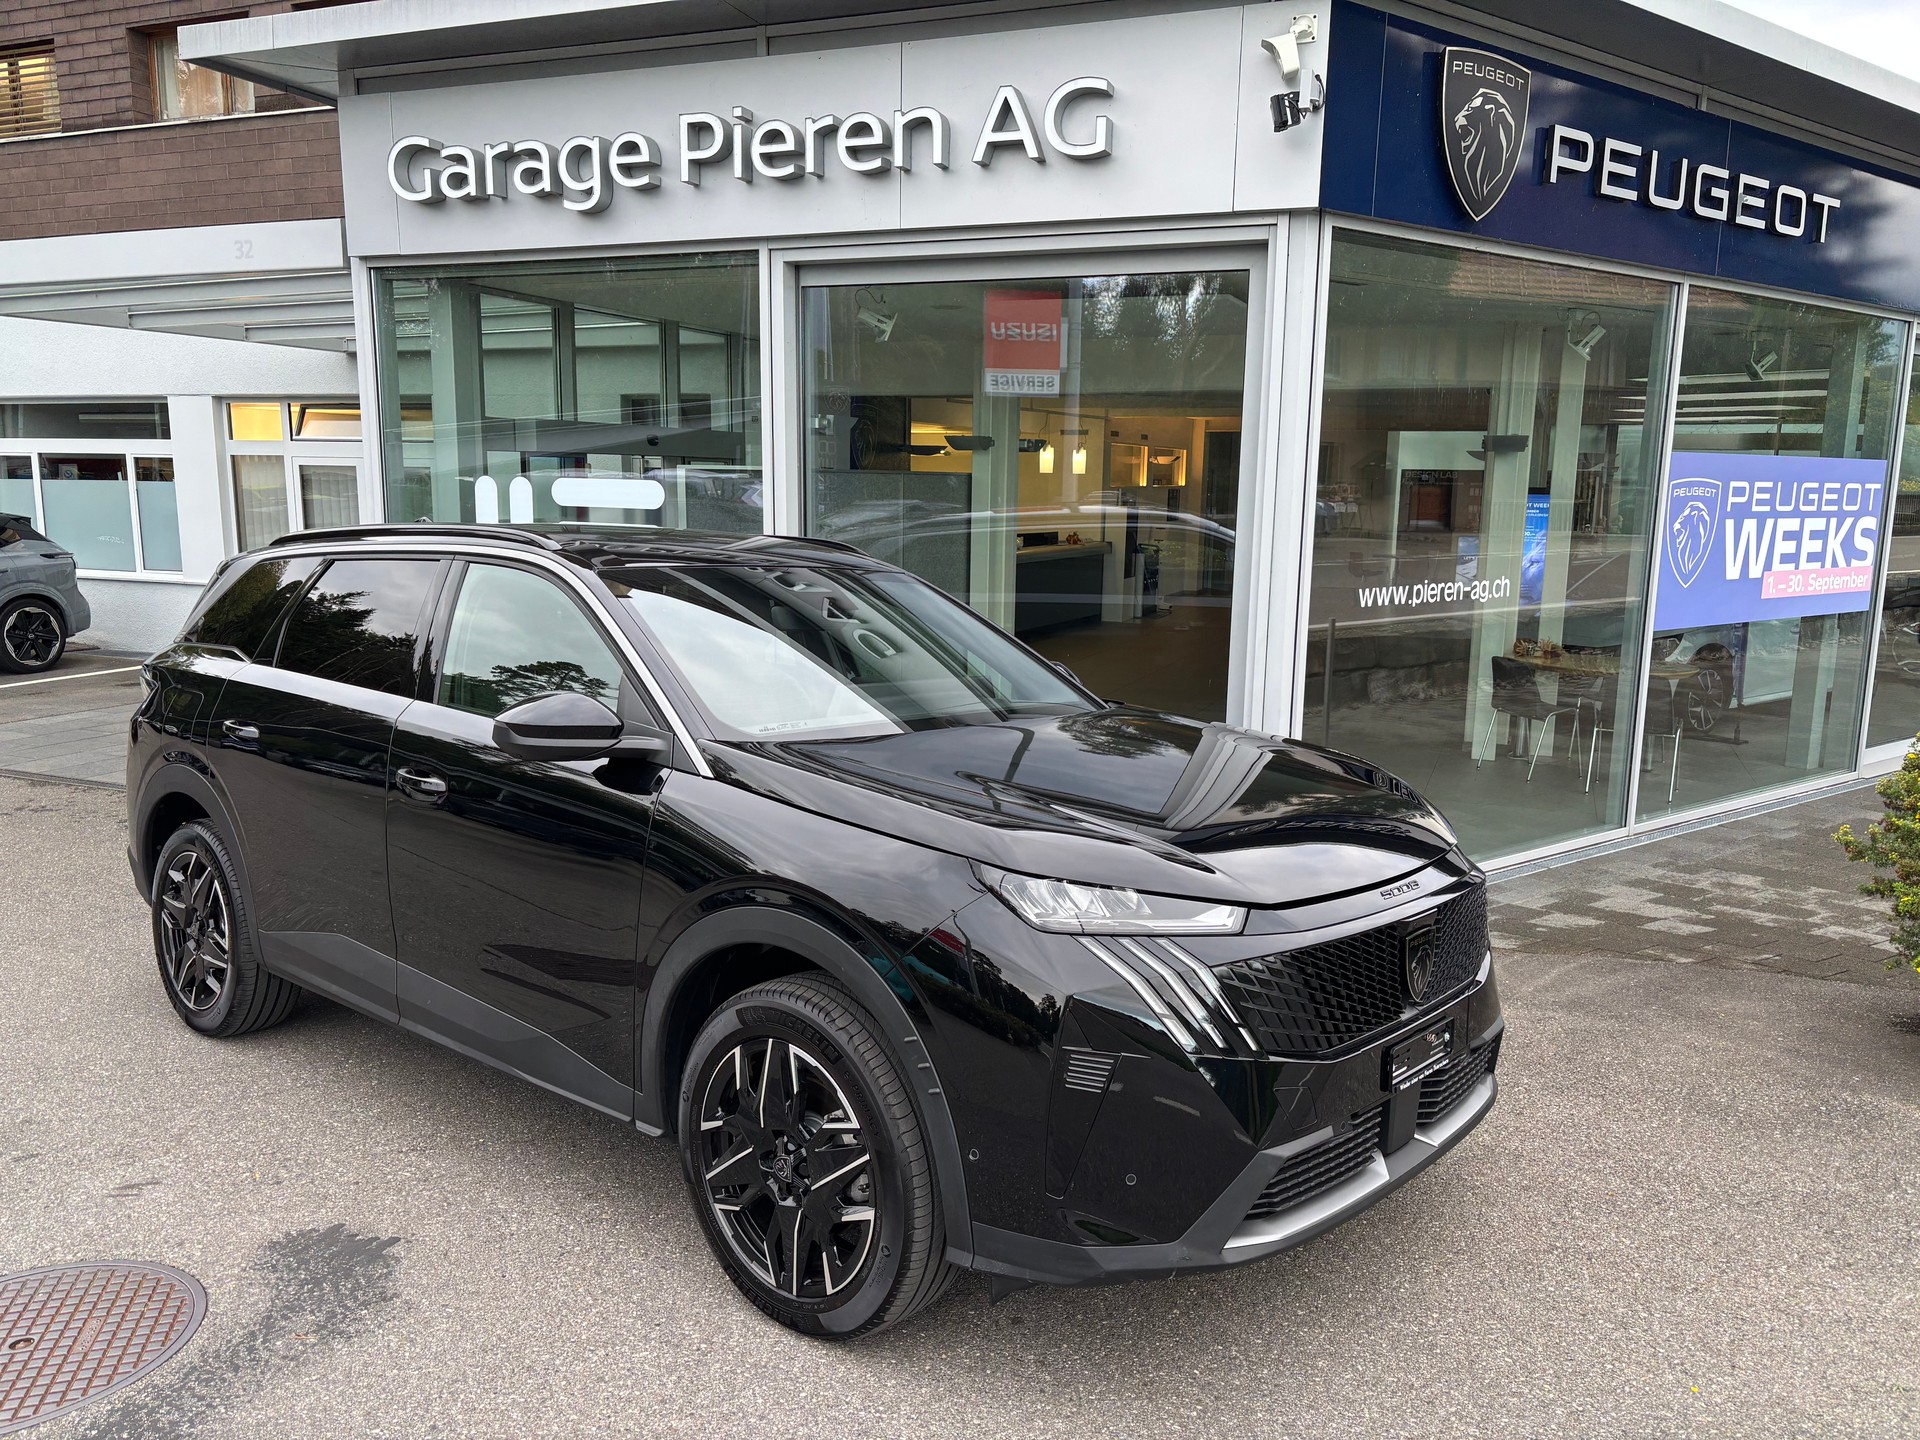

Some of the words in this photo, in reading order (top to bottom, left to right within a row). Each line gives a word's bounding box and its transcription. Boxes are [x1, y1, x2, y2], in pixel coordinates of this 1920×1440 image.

[1452, 60, 1525, 91] PEUGEOT
[387, 131, 662, 213] Garage
[679, 105, 951, 187] Pieren
[971, 76, 1115, 167] AG
[1549, 123, 1841, 244] PEUGEOT
[234, 239, 255, 260] 32
[1673, 486, 1717, 498] PEUGEOT
[1726, 480, 1882, 513] PEUGEOT
[1724, 515, 1878, 581] WEEKS
[1358, 575, 1511, 608] www.pieren-ag.ch
[1807, 573, 1868, 594] September
[1380, 880, 1421, 901] 5008
